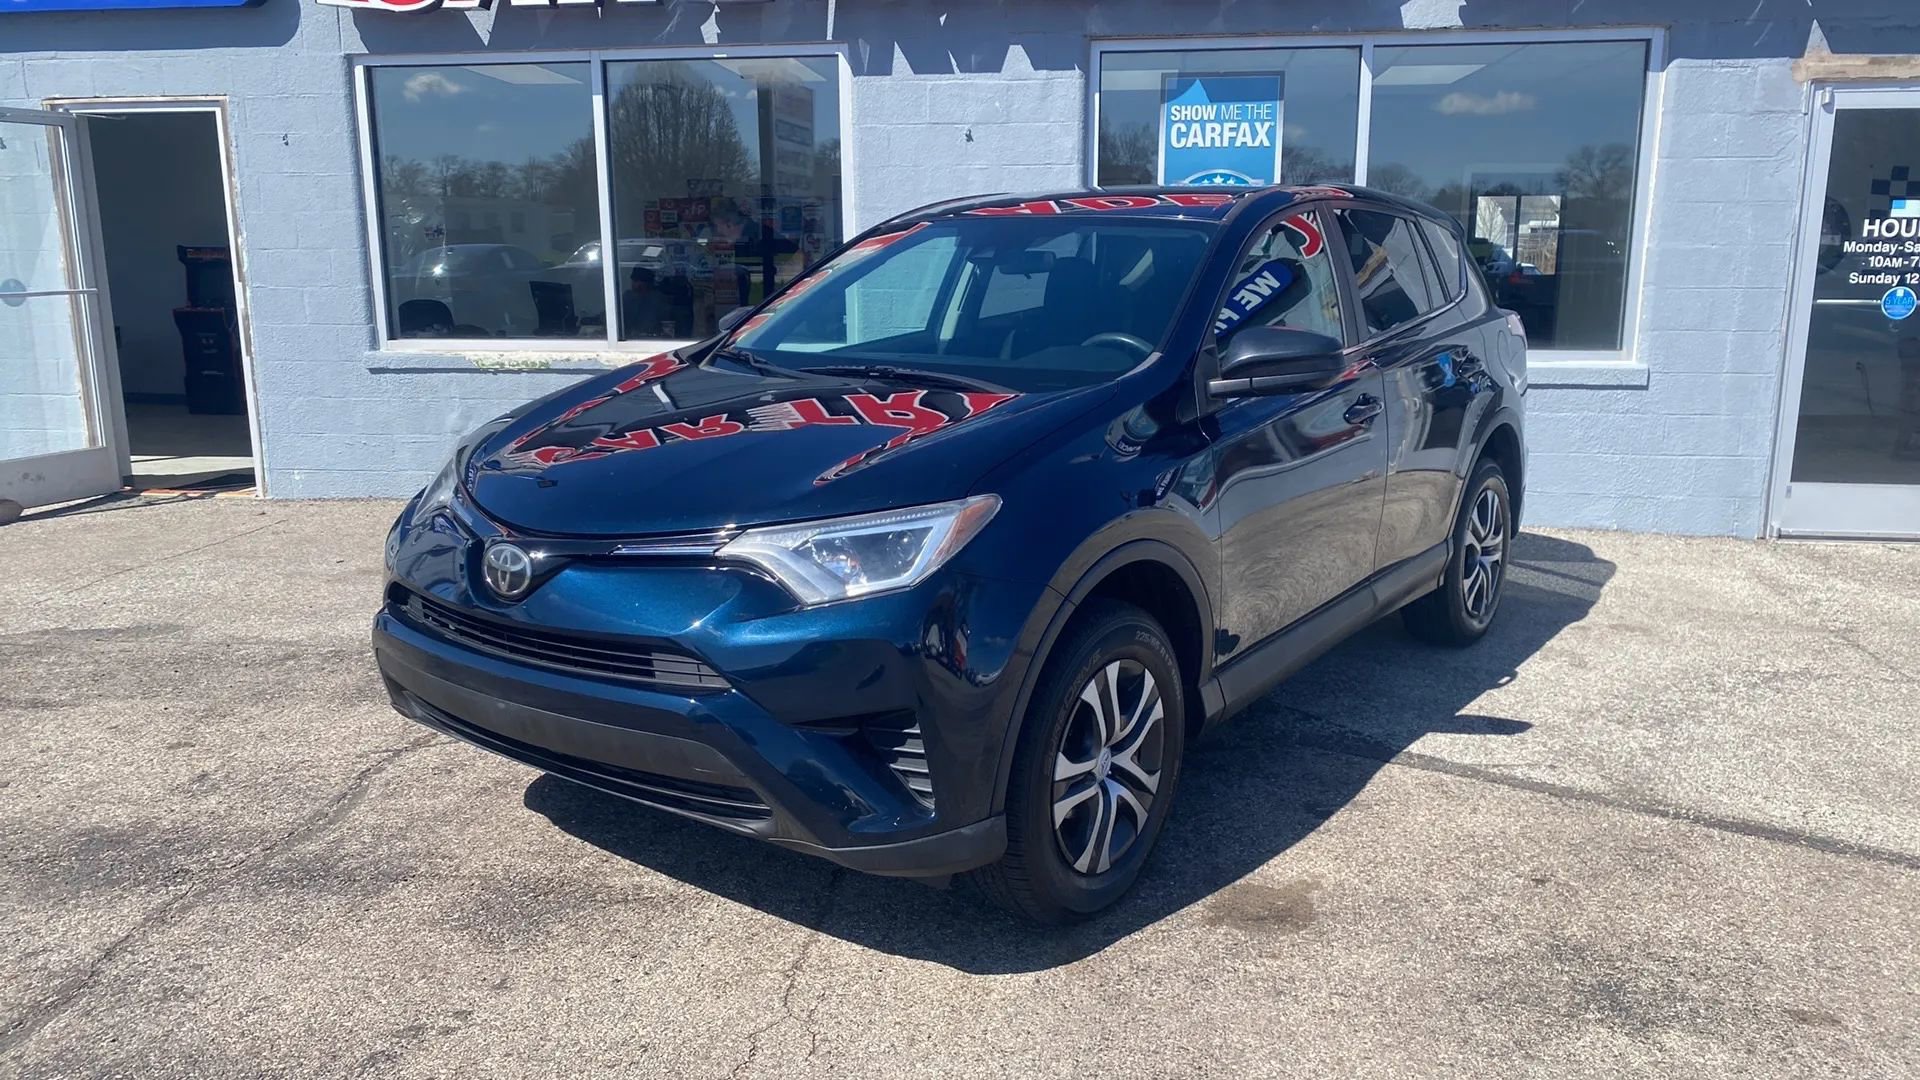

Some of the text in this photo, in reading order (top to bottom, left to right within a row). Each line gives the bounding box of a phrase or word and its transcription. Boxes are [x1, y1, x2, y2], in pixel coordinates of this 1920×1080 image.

[1170, 103, 1272, 121] SHOW ME THE
[1170, 121, 1272, 148] CARFAX
[1862, 218, 1920, 237] HOU
[1868, 256, 1920, 268] 10AM-7
[1849, 272, 1900, 286] Sunday
